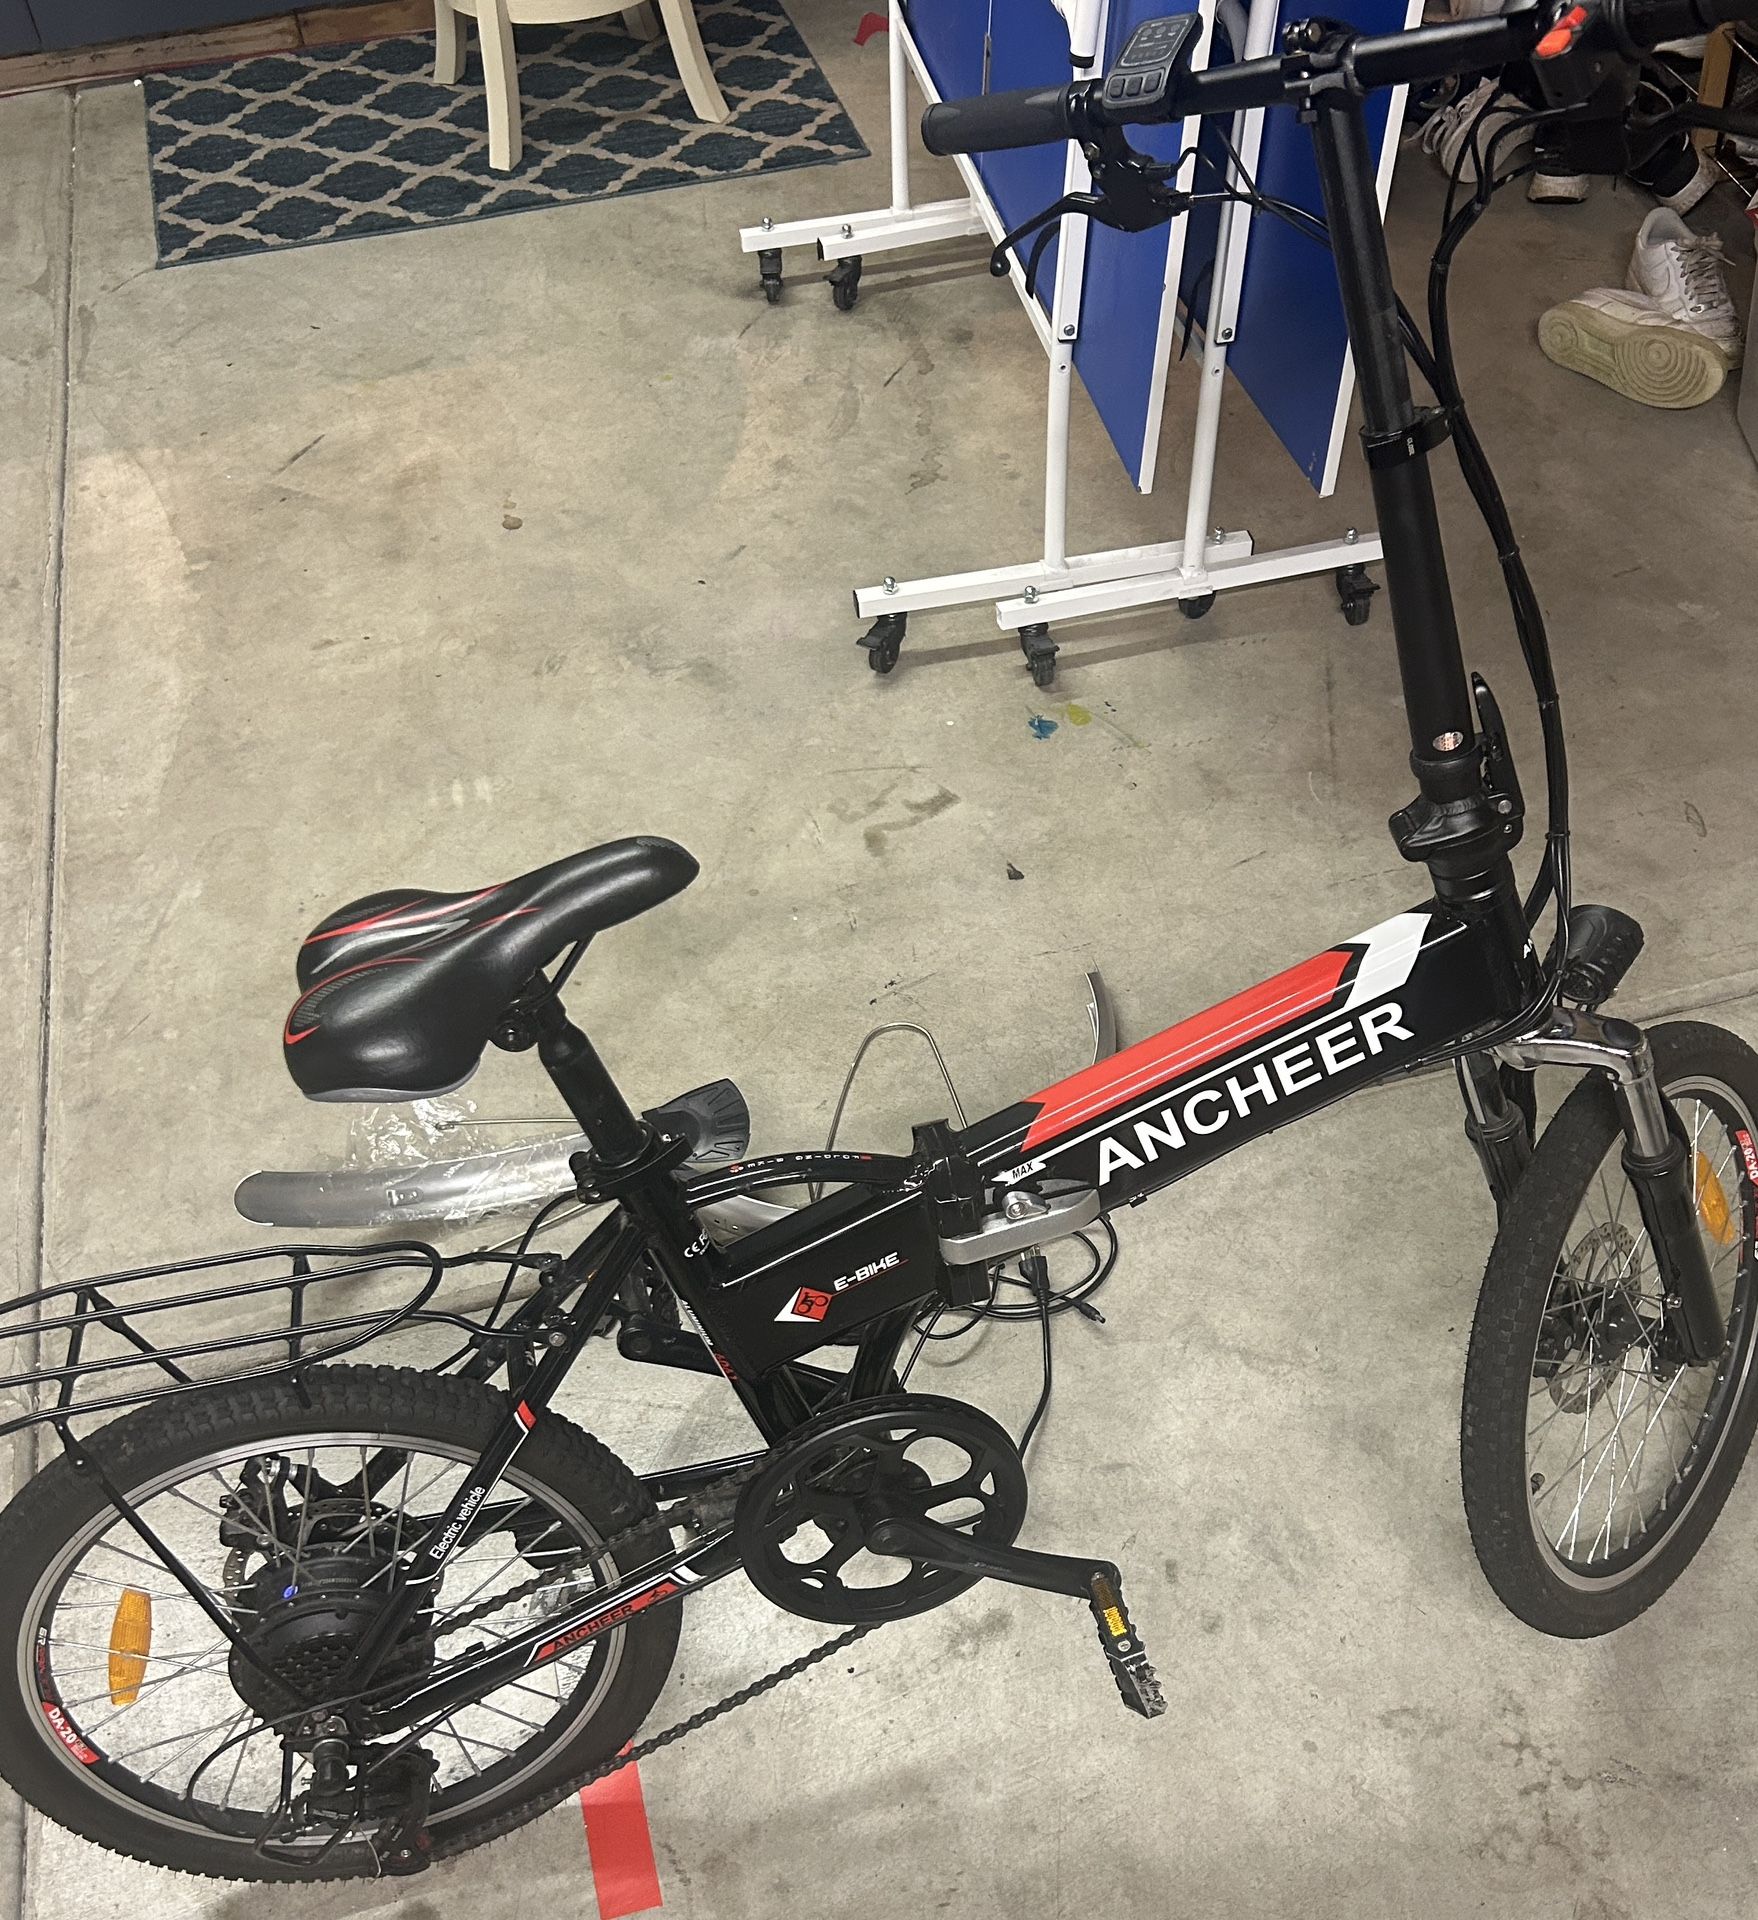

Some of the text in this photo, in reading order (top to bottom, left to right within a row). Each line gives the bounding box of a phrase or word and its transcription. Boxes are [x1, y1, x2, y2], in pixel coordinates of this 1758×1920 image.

[1099, 1002, 1415, 1187] ANCHEER
[1012, 1160, 1034, 1180] MAX
[684, 1241, 701, 1258] CE
[833, 1251, 900, 1292] E-BIKE
[429, 1486, 486, 1560] Electric vehicle
[552, 1604, 635, 1651] ANCHEER
